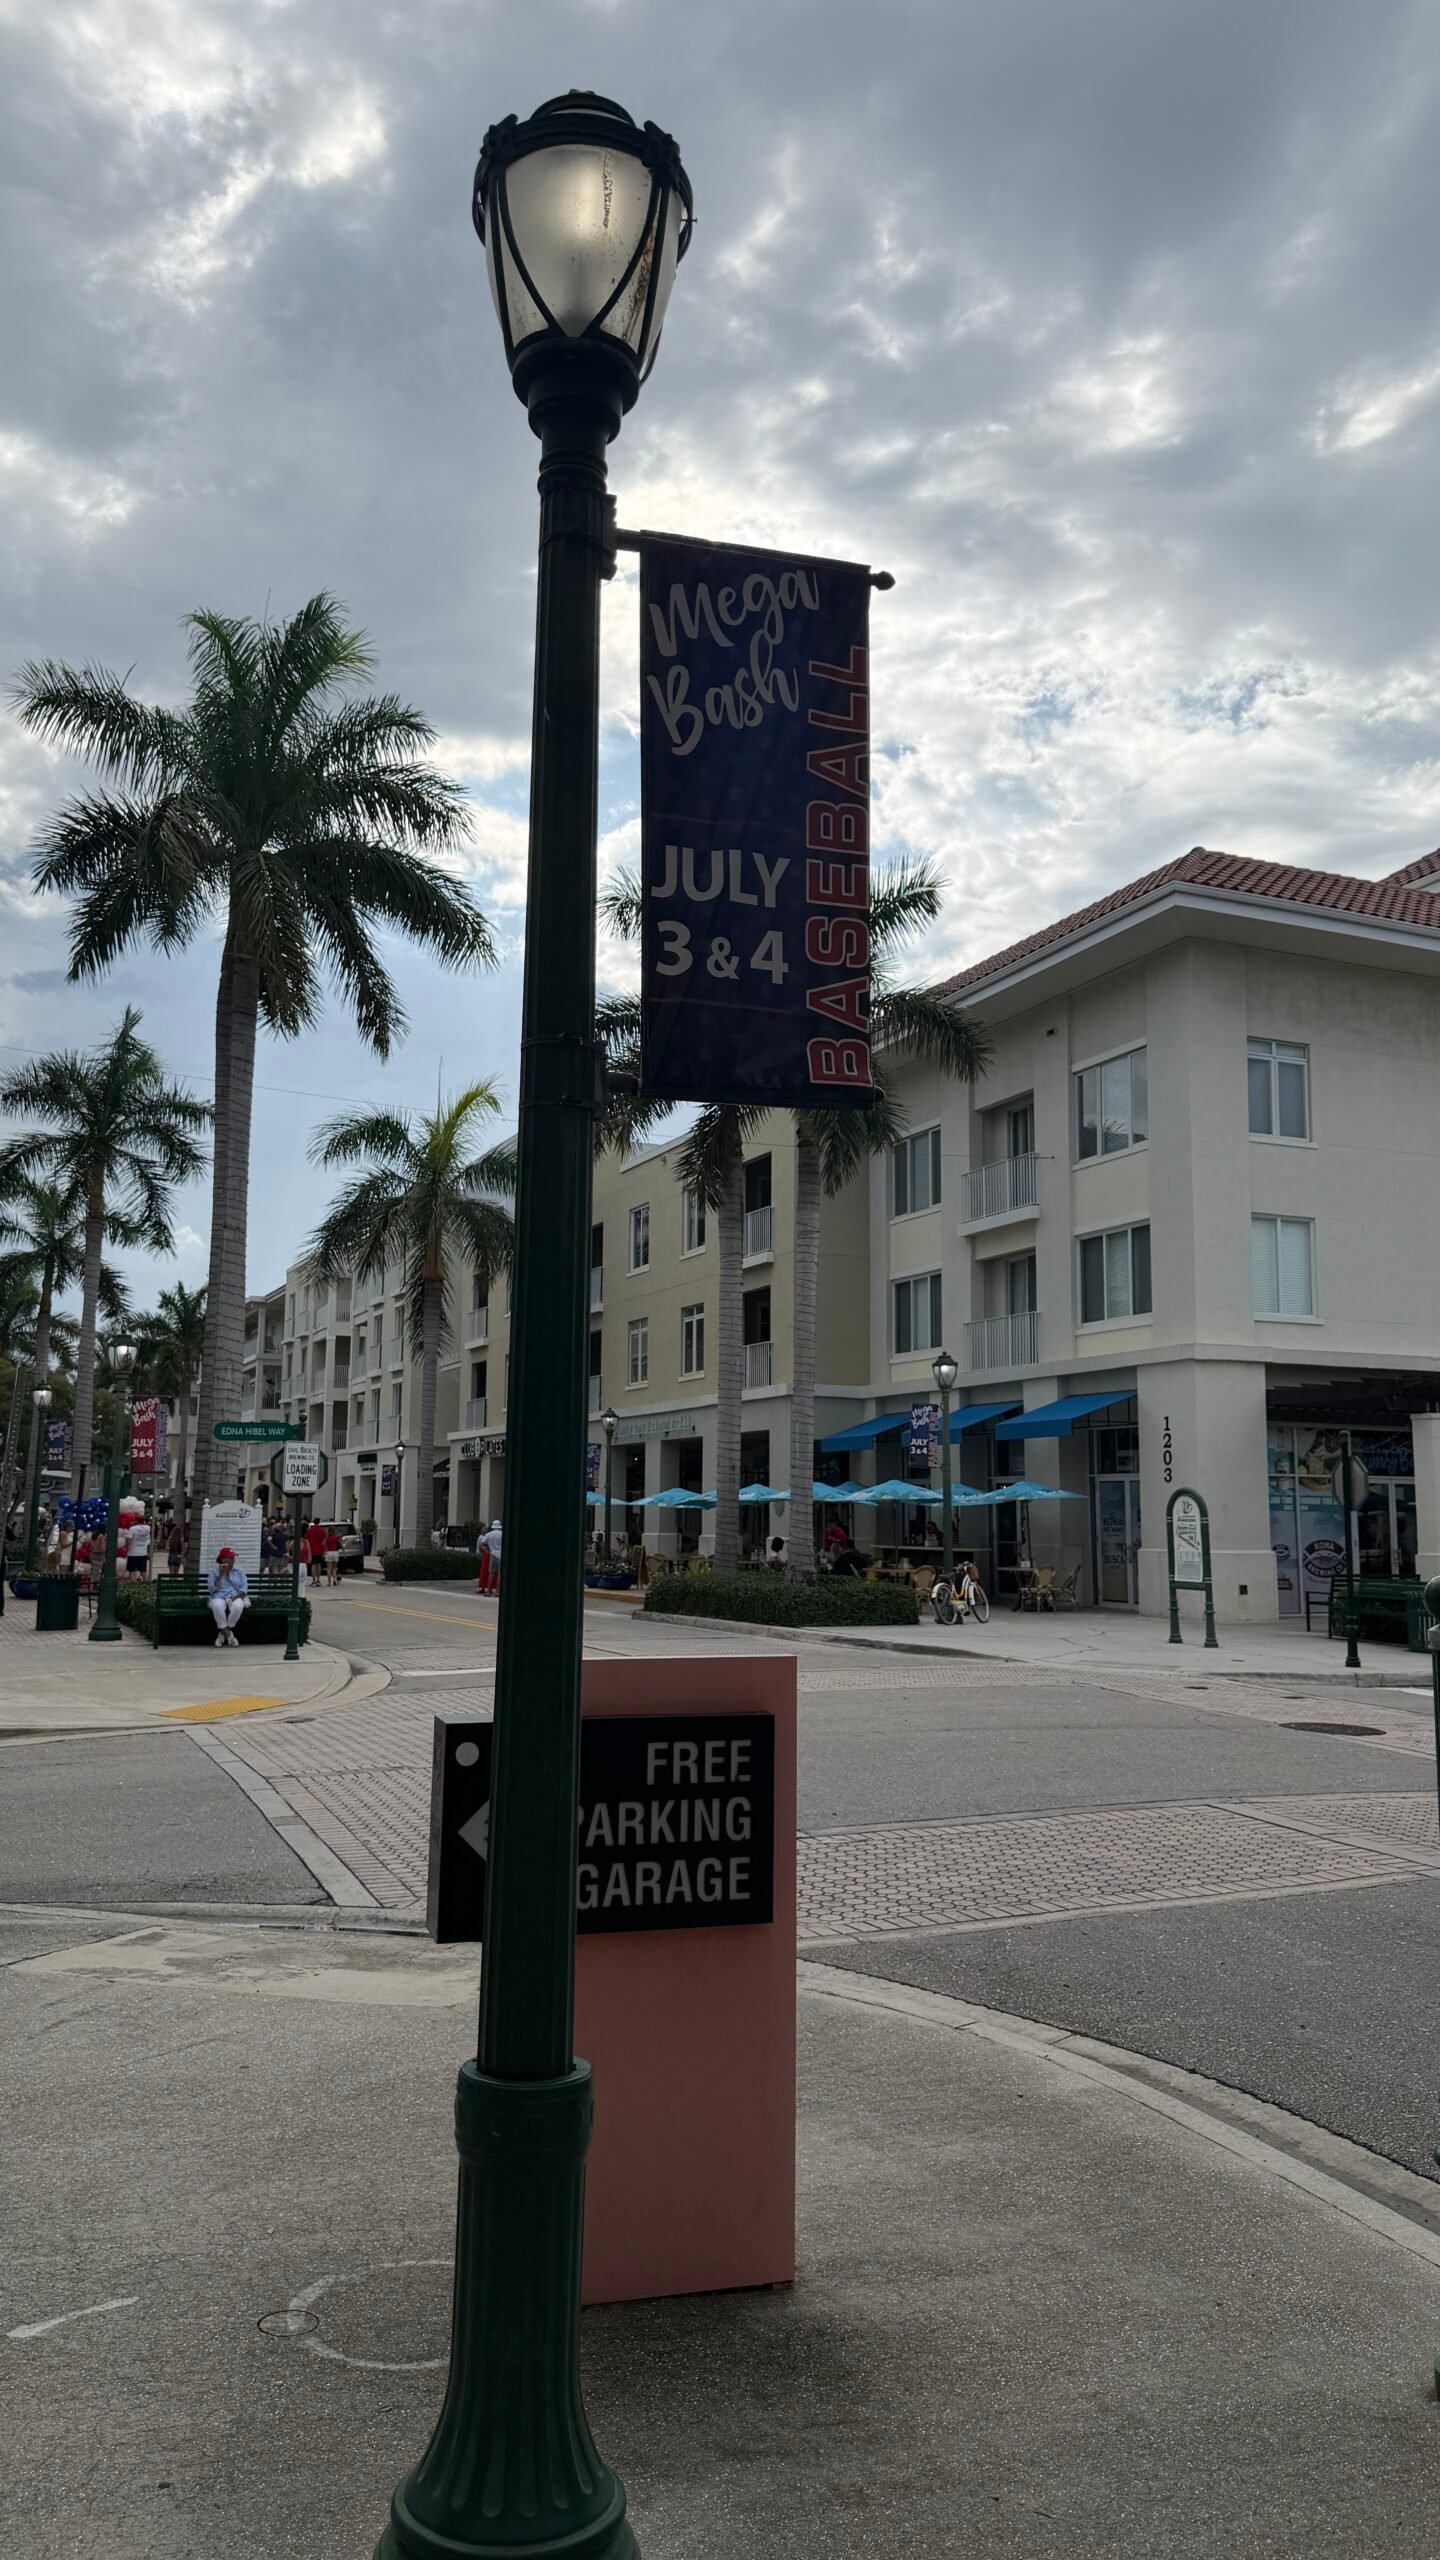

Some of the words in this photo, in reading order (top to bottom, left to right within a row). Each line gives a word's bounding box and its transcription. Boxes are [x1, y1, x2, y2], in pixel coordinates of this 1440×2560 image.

[648, 568, 820, 658] Mega
[647, 629, 800, 756] Bash
[651, 845, 791, 909] JULY
[806, 645, 873, 1086] BASEBALL
[655, 920, 694, 977] 3
[706, 936, 741, 980] &
[750, 930, 790, 986] 4
[131, 1438, 154, 1448] JULY
[221, 1427, 244, 1436] EDNA
[245, 1427, 267, 1436] HIBEL
[268, 1427, 286, 1436] WAY
[910, 1438, 928, 1446] JULY
[131, 1449, 138, 1458] 3
[146, 1449, 153, 1458] 4
[922, 1447, 928, 1455] 4
[1163, 1415, 1173, 1483] 1203
[287, 1464, 317, 1475] LOADING
[292, 1476, 311, 1487] ZONE
[1313, 1541, 1336, 1551] KONA
[646, 1739, 752, 1786] FREE
[576, 1856, 752, 1910] GARAGE
